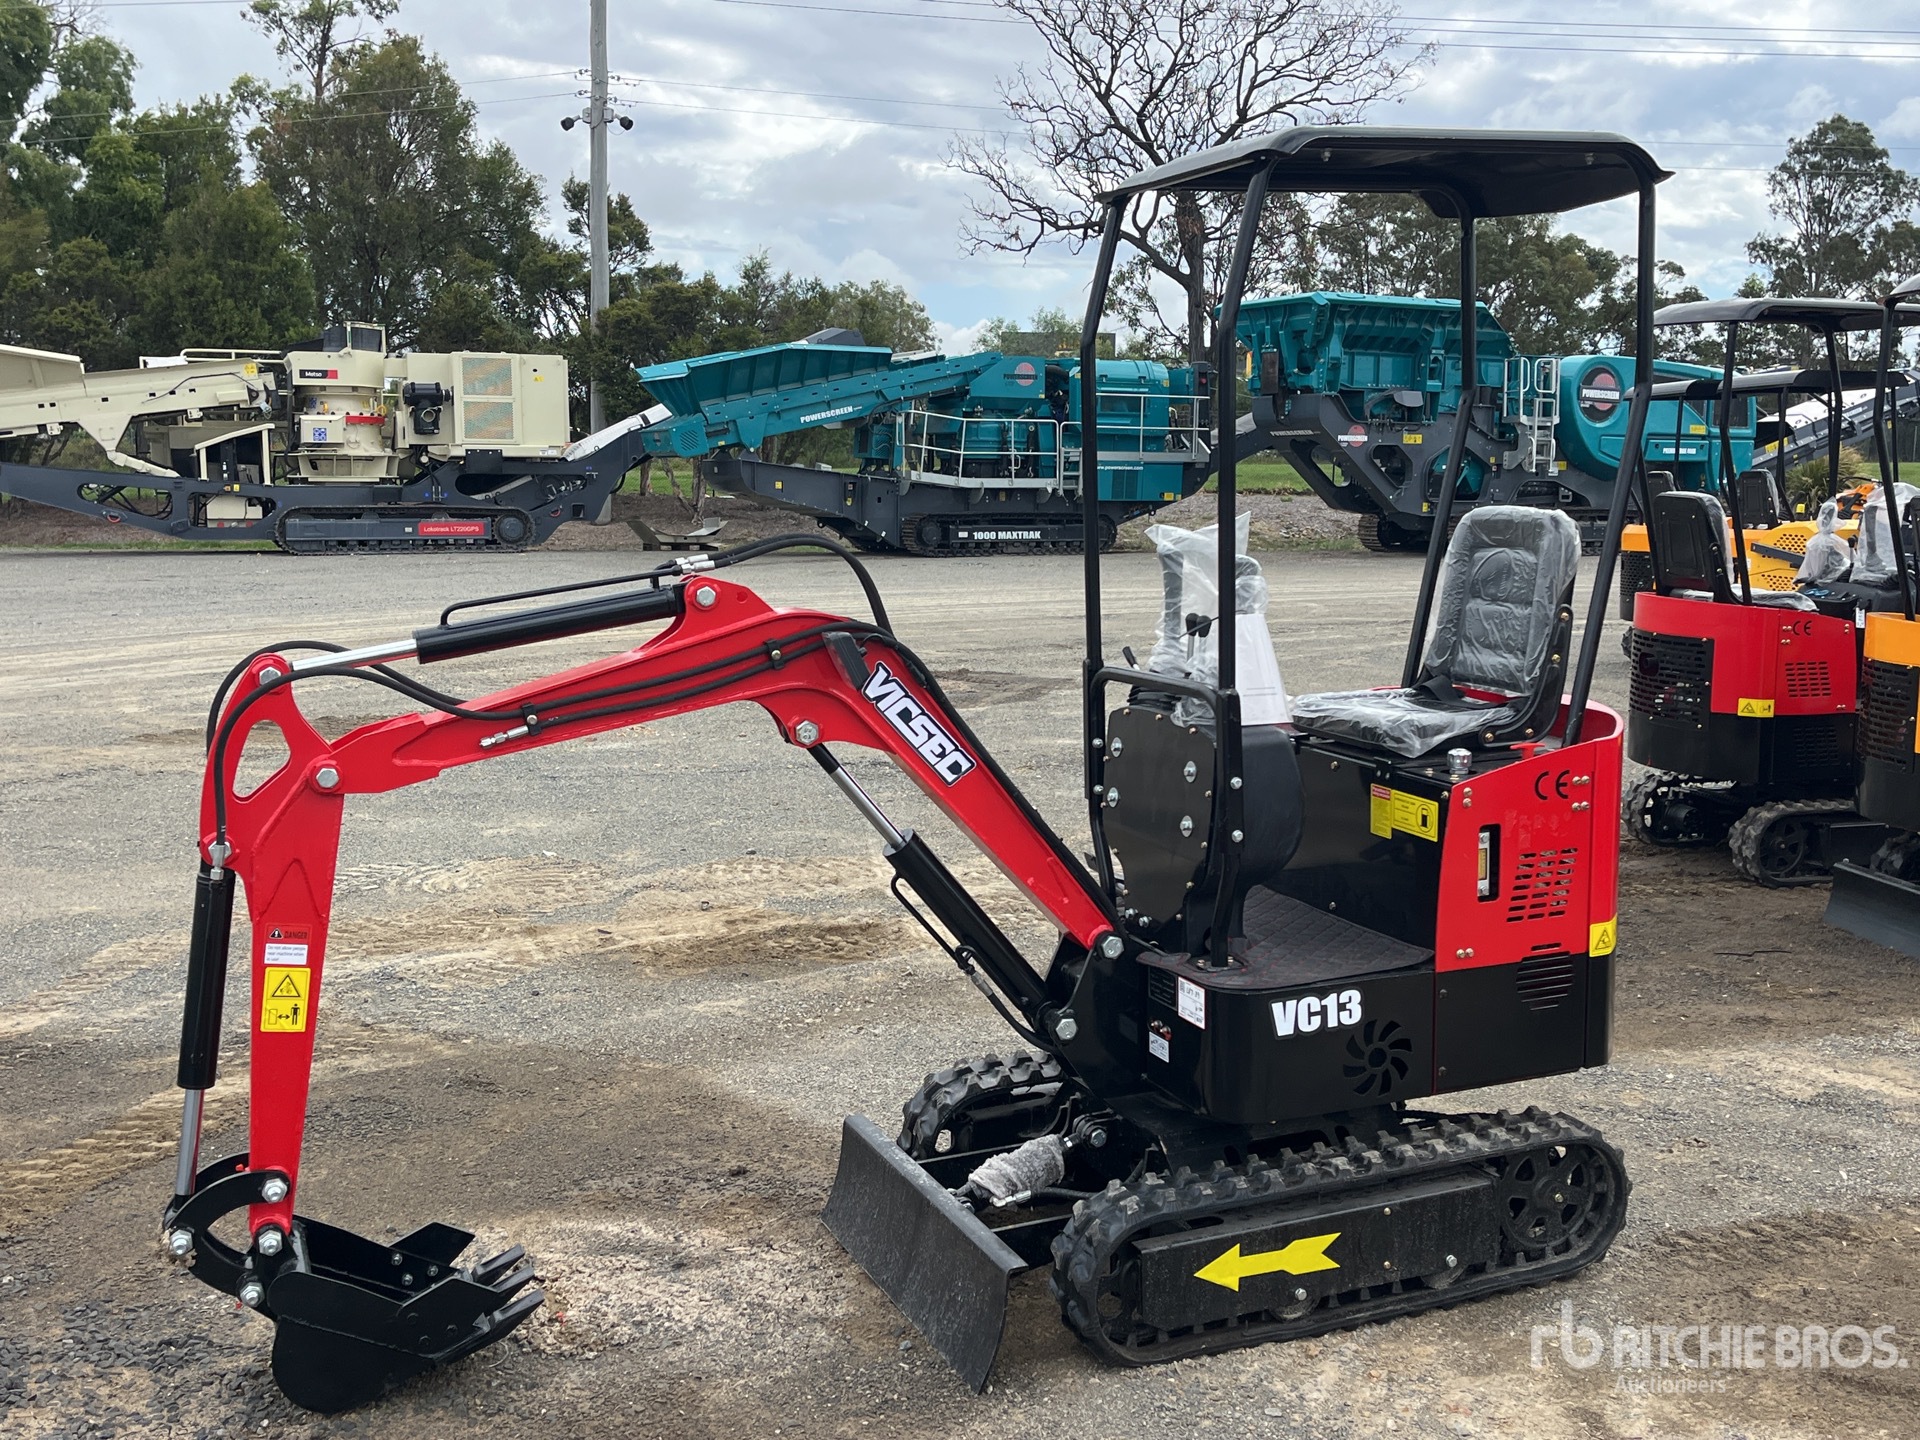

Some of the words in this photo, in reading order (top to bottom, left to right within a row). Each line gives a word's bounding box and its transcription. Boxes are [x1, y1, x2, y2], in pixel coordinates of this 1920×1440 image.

[1581, 388, 1620, 400] POWERSCREEN
[800, 405, 853, 424] POWERSCREEN
[1269, 429, 1314, 437] POWERSCREEN
[973, 531, 996, 540] 1000
[998, 531, 1041, 540] MAXTRAK
[863, 662, 975, 785] VICSEC
[1534, 769, 1570, 801] CE
[284, 931, 308, 939] DANGER
[1271, 989, 1362, 1036] VC13
